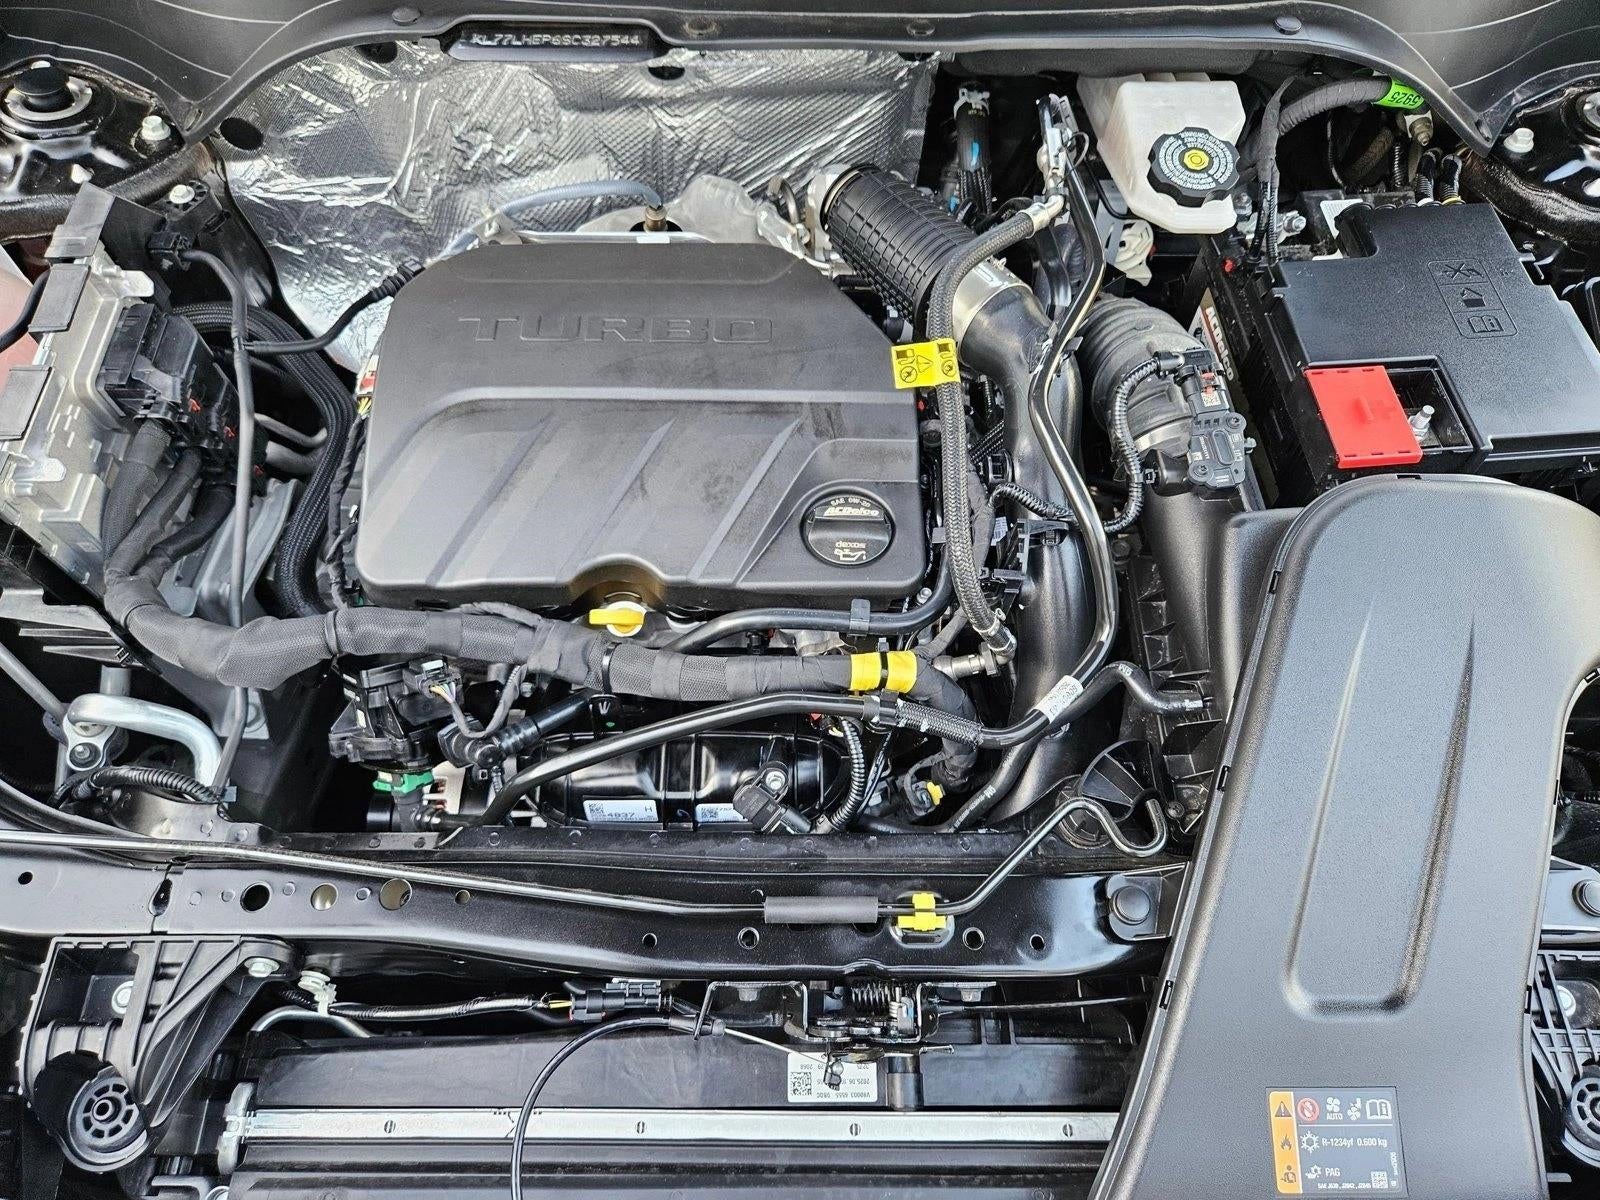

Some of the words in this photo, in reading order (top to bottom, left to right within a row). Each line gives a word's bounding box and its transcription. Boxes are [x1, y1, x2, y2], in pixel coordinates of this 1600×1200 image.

[458, 315, 773, 343] TURBO
[1321, 1138, 1354, 1148] R-1234yf
[1378, 1138, 1388, 1148] kg
[1325, 1167, 1341, 1177] PAG
